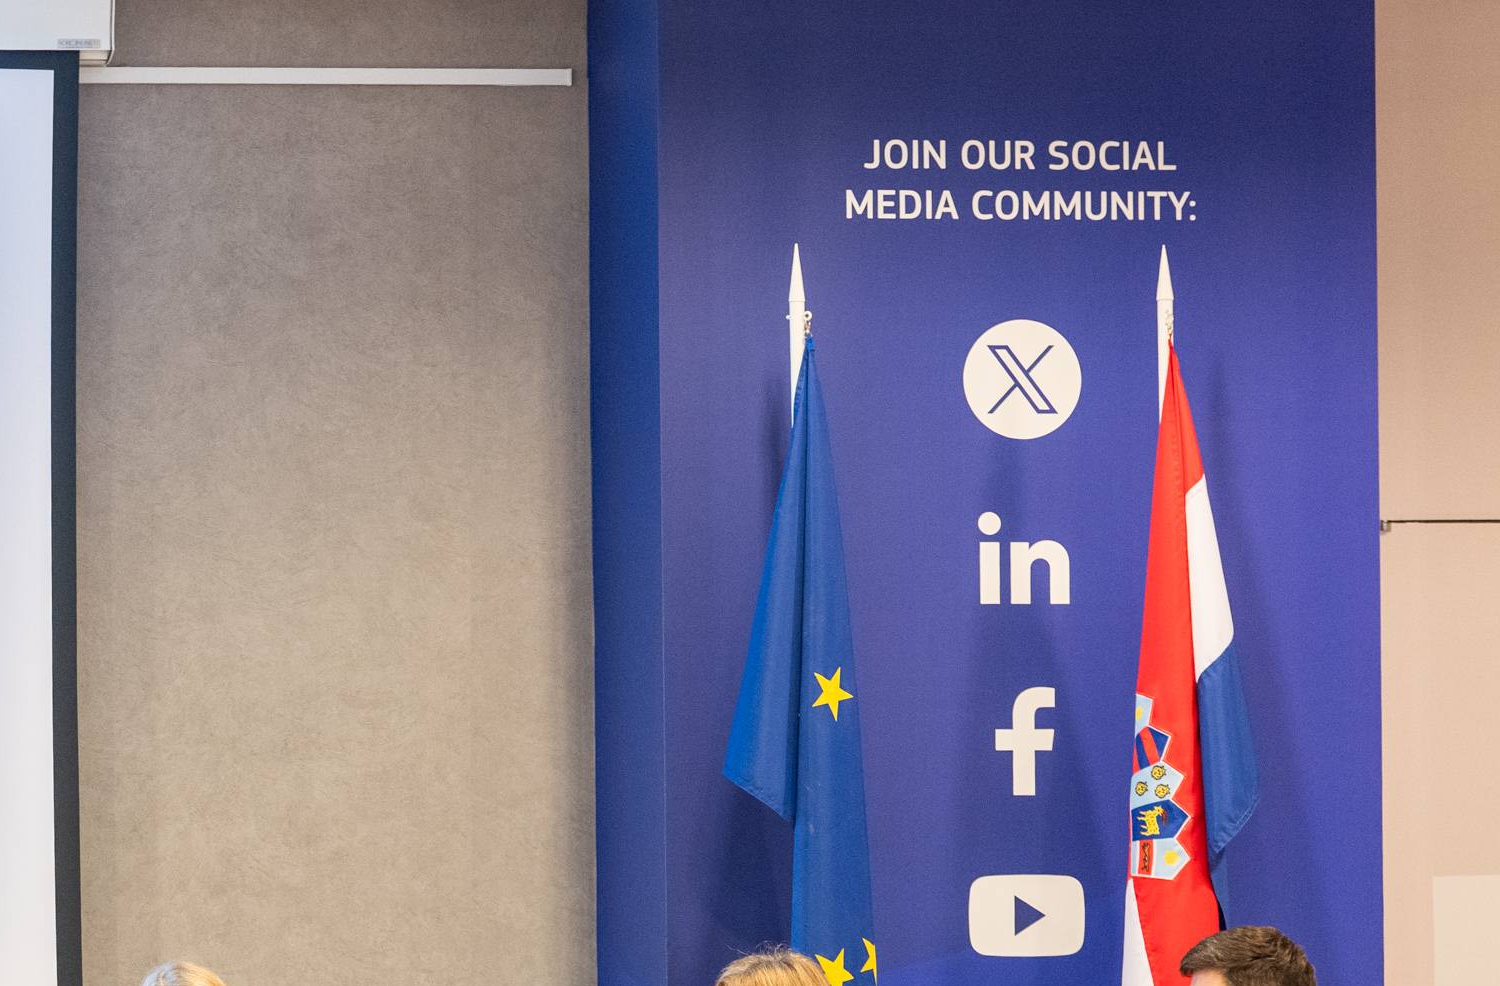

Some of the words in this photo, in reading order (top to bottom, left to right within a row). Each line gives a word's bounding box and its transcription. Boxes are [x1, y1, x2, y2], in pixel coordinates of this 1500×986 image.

[863, 138, 947, 170] JOIN
[961, 139, 1036, 170] OUR
[1048, 140, 1177, 171] SOCIAL
[845, 189, 960, 220] MEDIA
[971, 189, 1197, 221] COMMUNITY:
